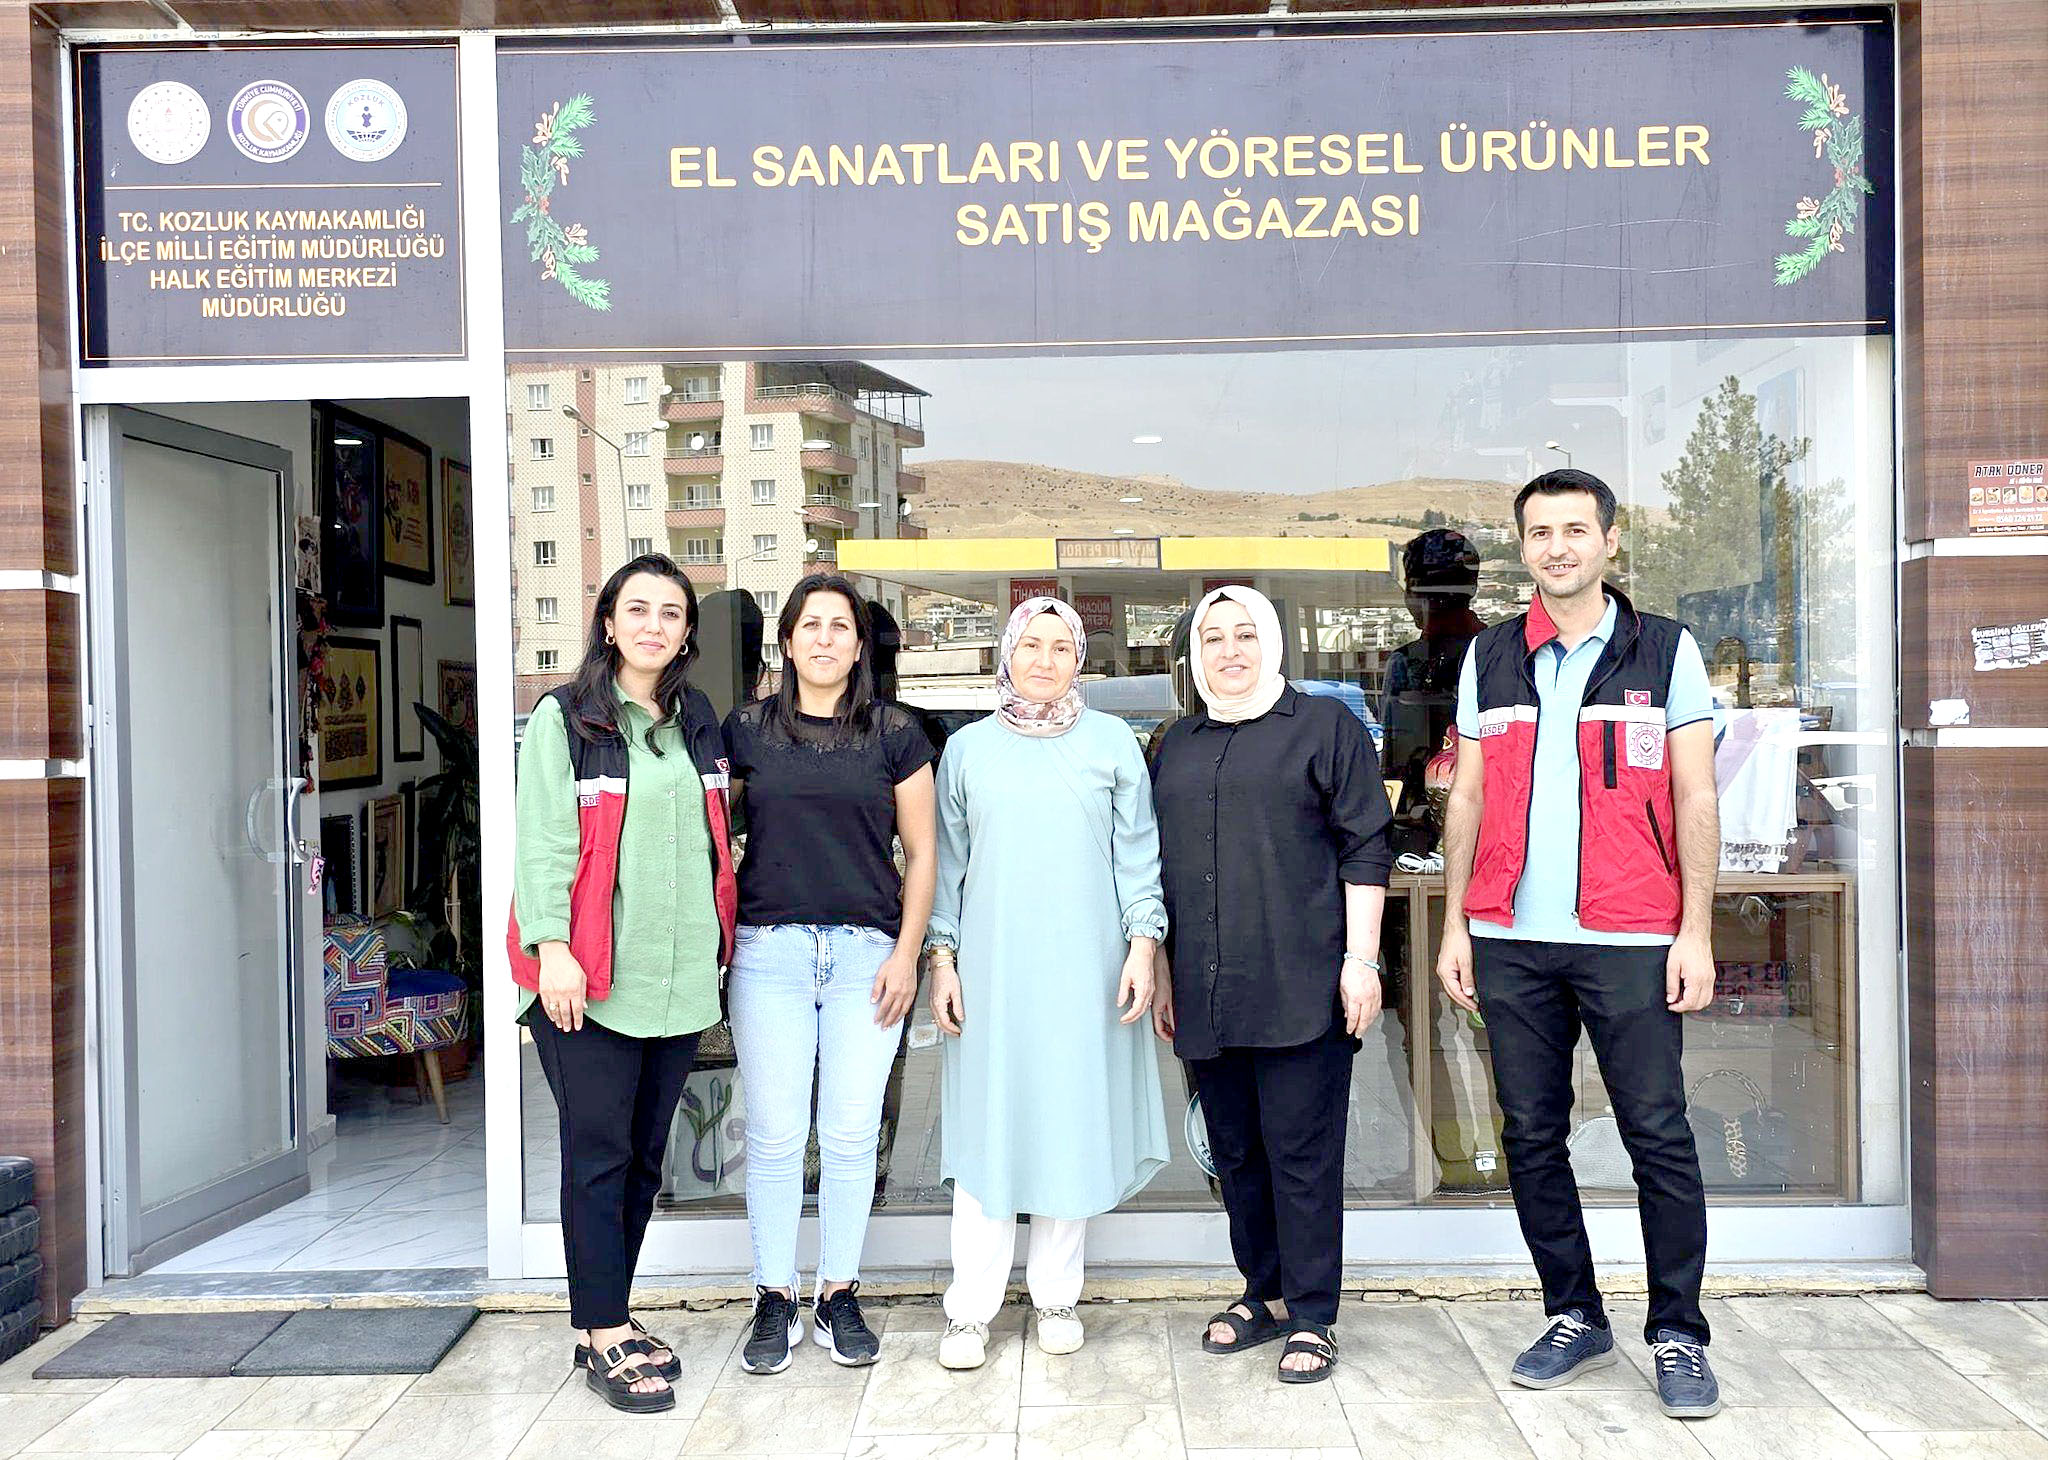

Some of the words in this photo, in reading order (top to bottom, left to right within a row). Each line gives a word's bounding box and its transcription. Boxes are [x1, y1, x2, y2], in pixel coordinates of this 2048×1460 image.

[669, 146, 737, 188] EL
[752, 139, 1060, 188] SANATLARI
[1076, 138, 1150, 181] VE
[1164, 128, 1424, 180] YÖRESEL
[1440, 120, 1711, 173] ÜRÜNLER
[117, 212, 153, 232] TC.
[159, 210, 250, 231] KOZLUK
[255, 203, 425, 231] KAYMAKAMLIĞI
[955, 200, 1112, 254] SATIŞ
[1128, 186, 1420, 243] MAĞAZASI
[100, 235, 151, 266] İLÇE
[156, 234, 214, 261] MİLLİ
[219, 234, 296, 260] EĞİTİM
[301, 232, 445, 259] MÜDÜRLÜĞÜ
[150, 268, 210, 290] HALK
[216, 263, 292, 289] EĞİTİM
[298, 261, 398, 287] MERKEZİ
[201, 292, 346, 318] MÜDÜRLÜĞÜ
[1974, 464, 2003, 477] ATAK
